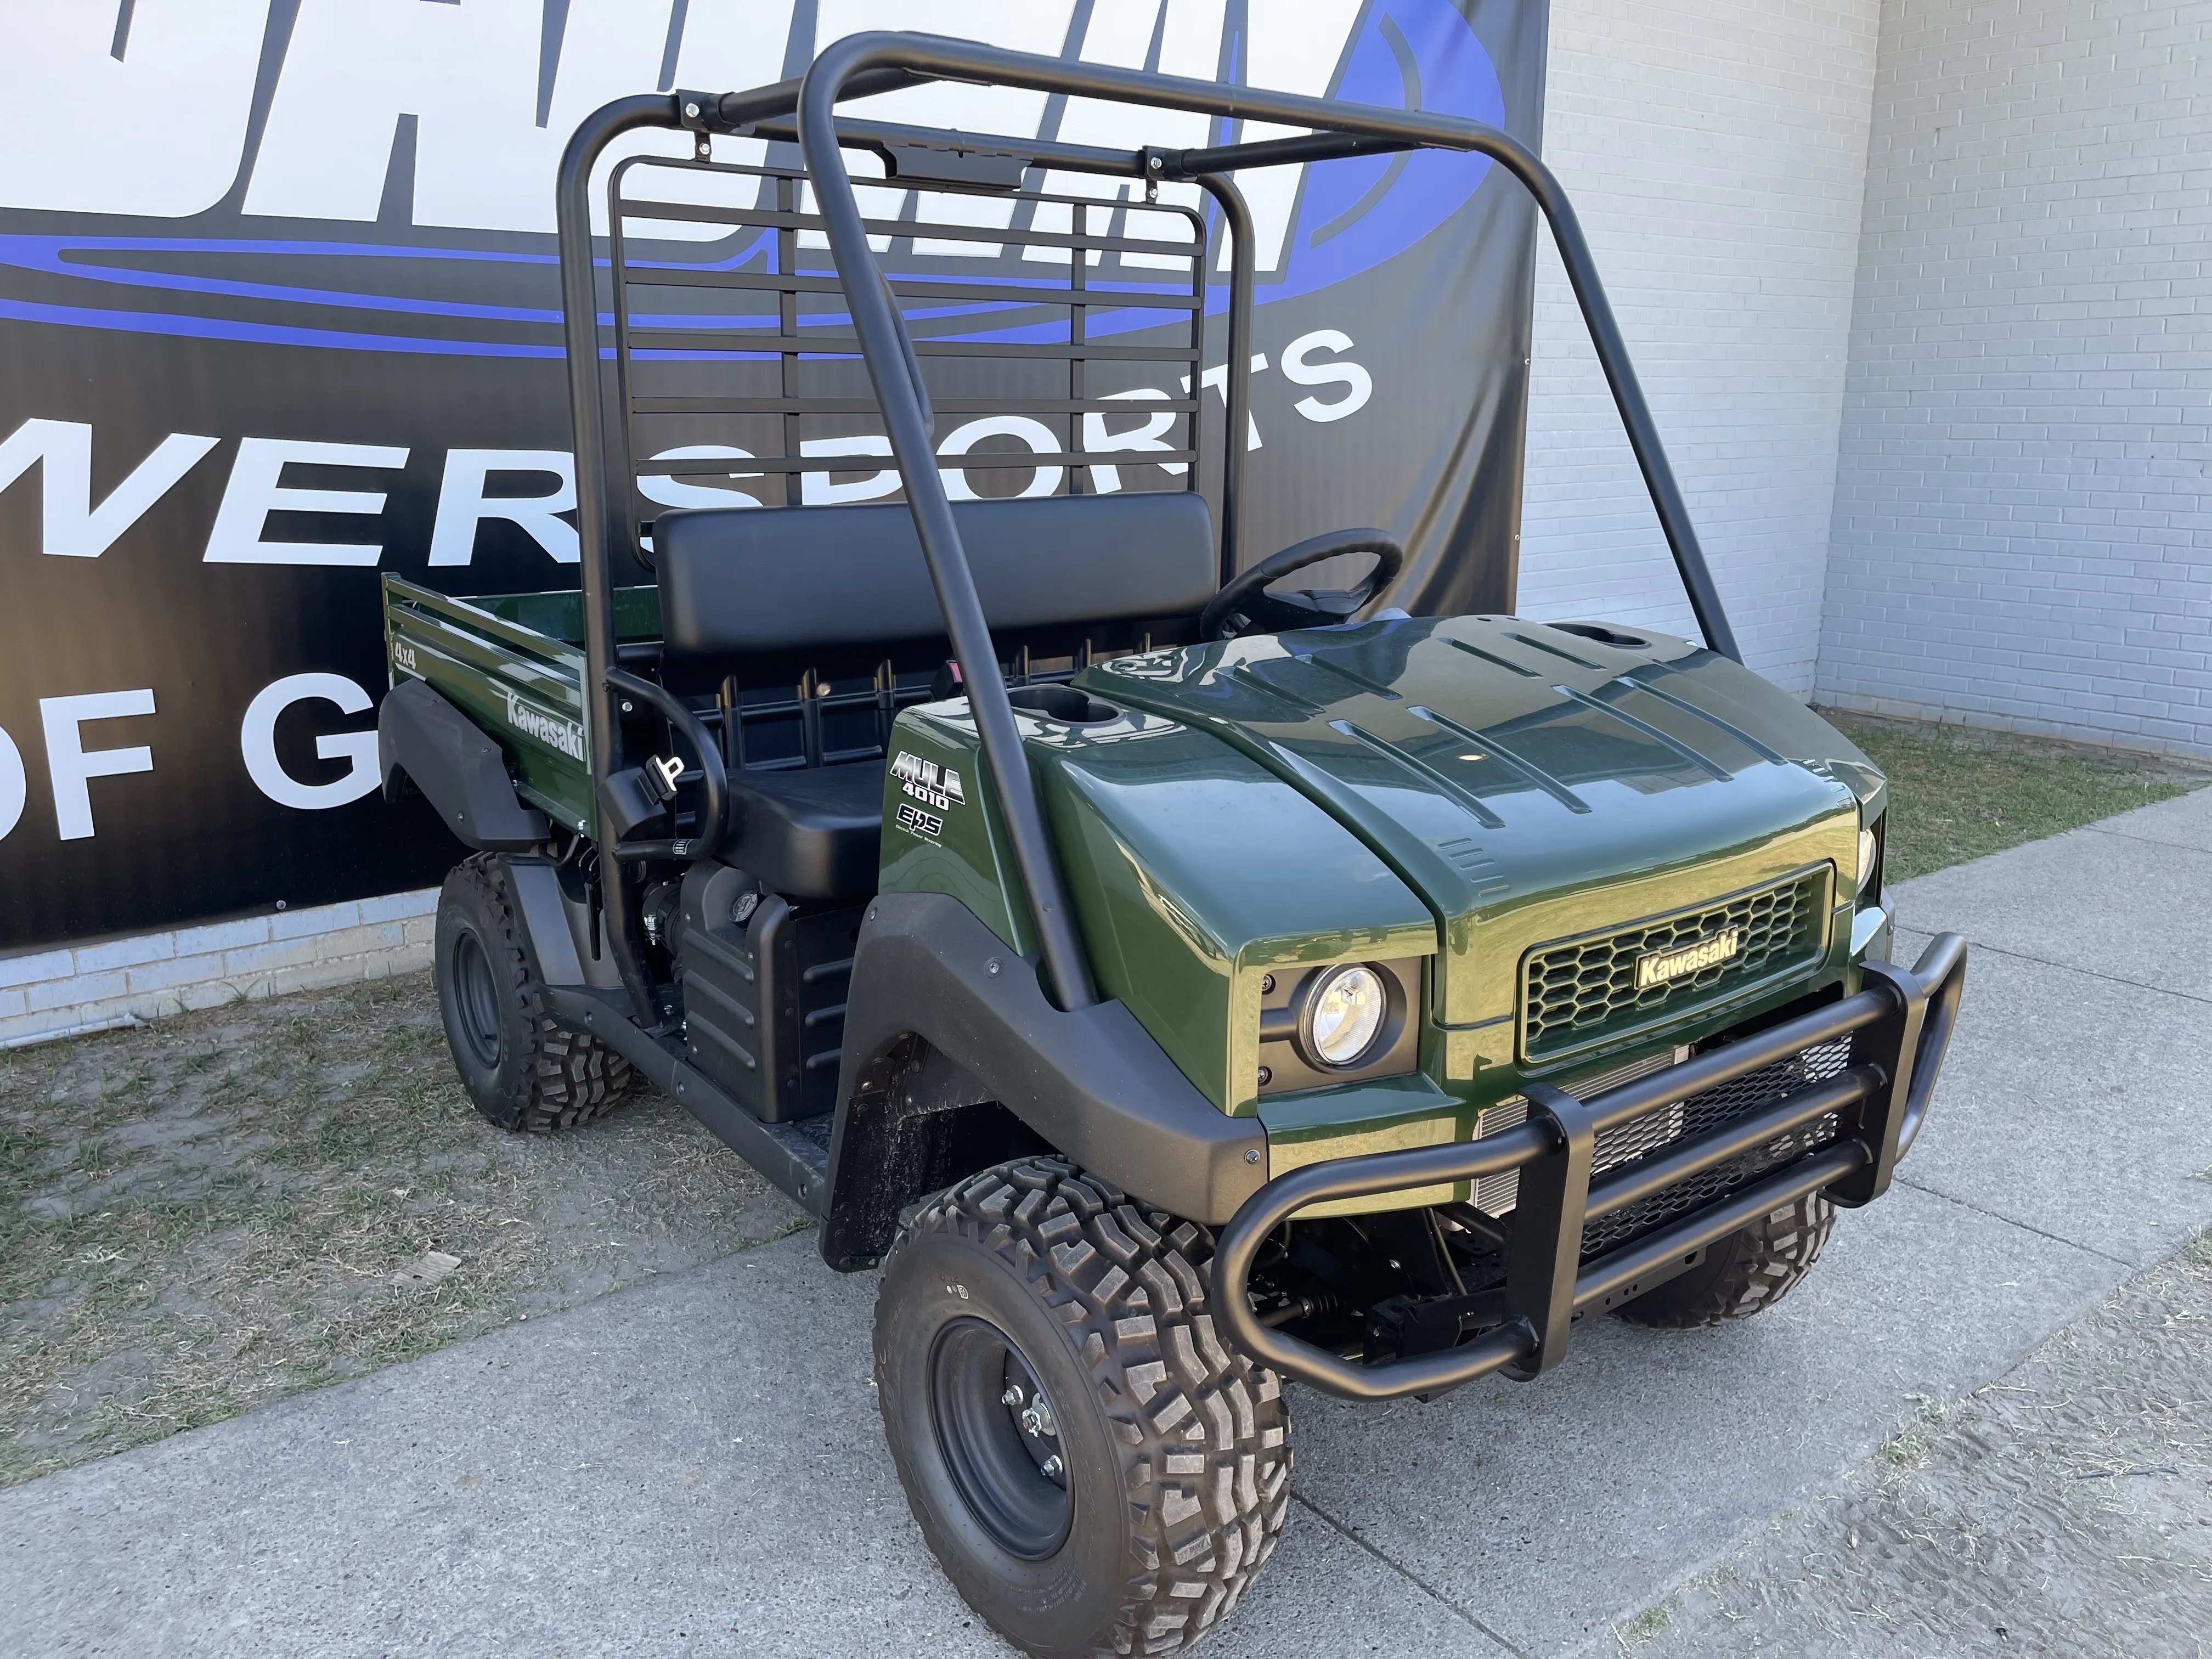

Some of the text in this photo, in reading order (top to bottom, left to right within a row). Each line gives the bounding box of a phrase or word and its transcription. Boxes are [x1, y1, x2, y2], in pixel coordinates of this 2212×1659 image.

[395, 642, 416, 669] 4x4
[506, 692, 585, 762] Kawasaki
[0, 689, 156, 841] F
[889, 750, 966, 805] MULE
[902, 782, 950, 811] 4010
[1640, 930, 1739, 986] Kawasaki
